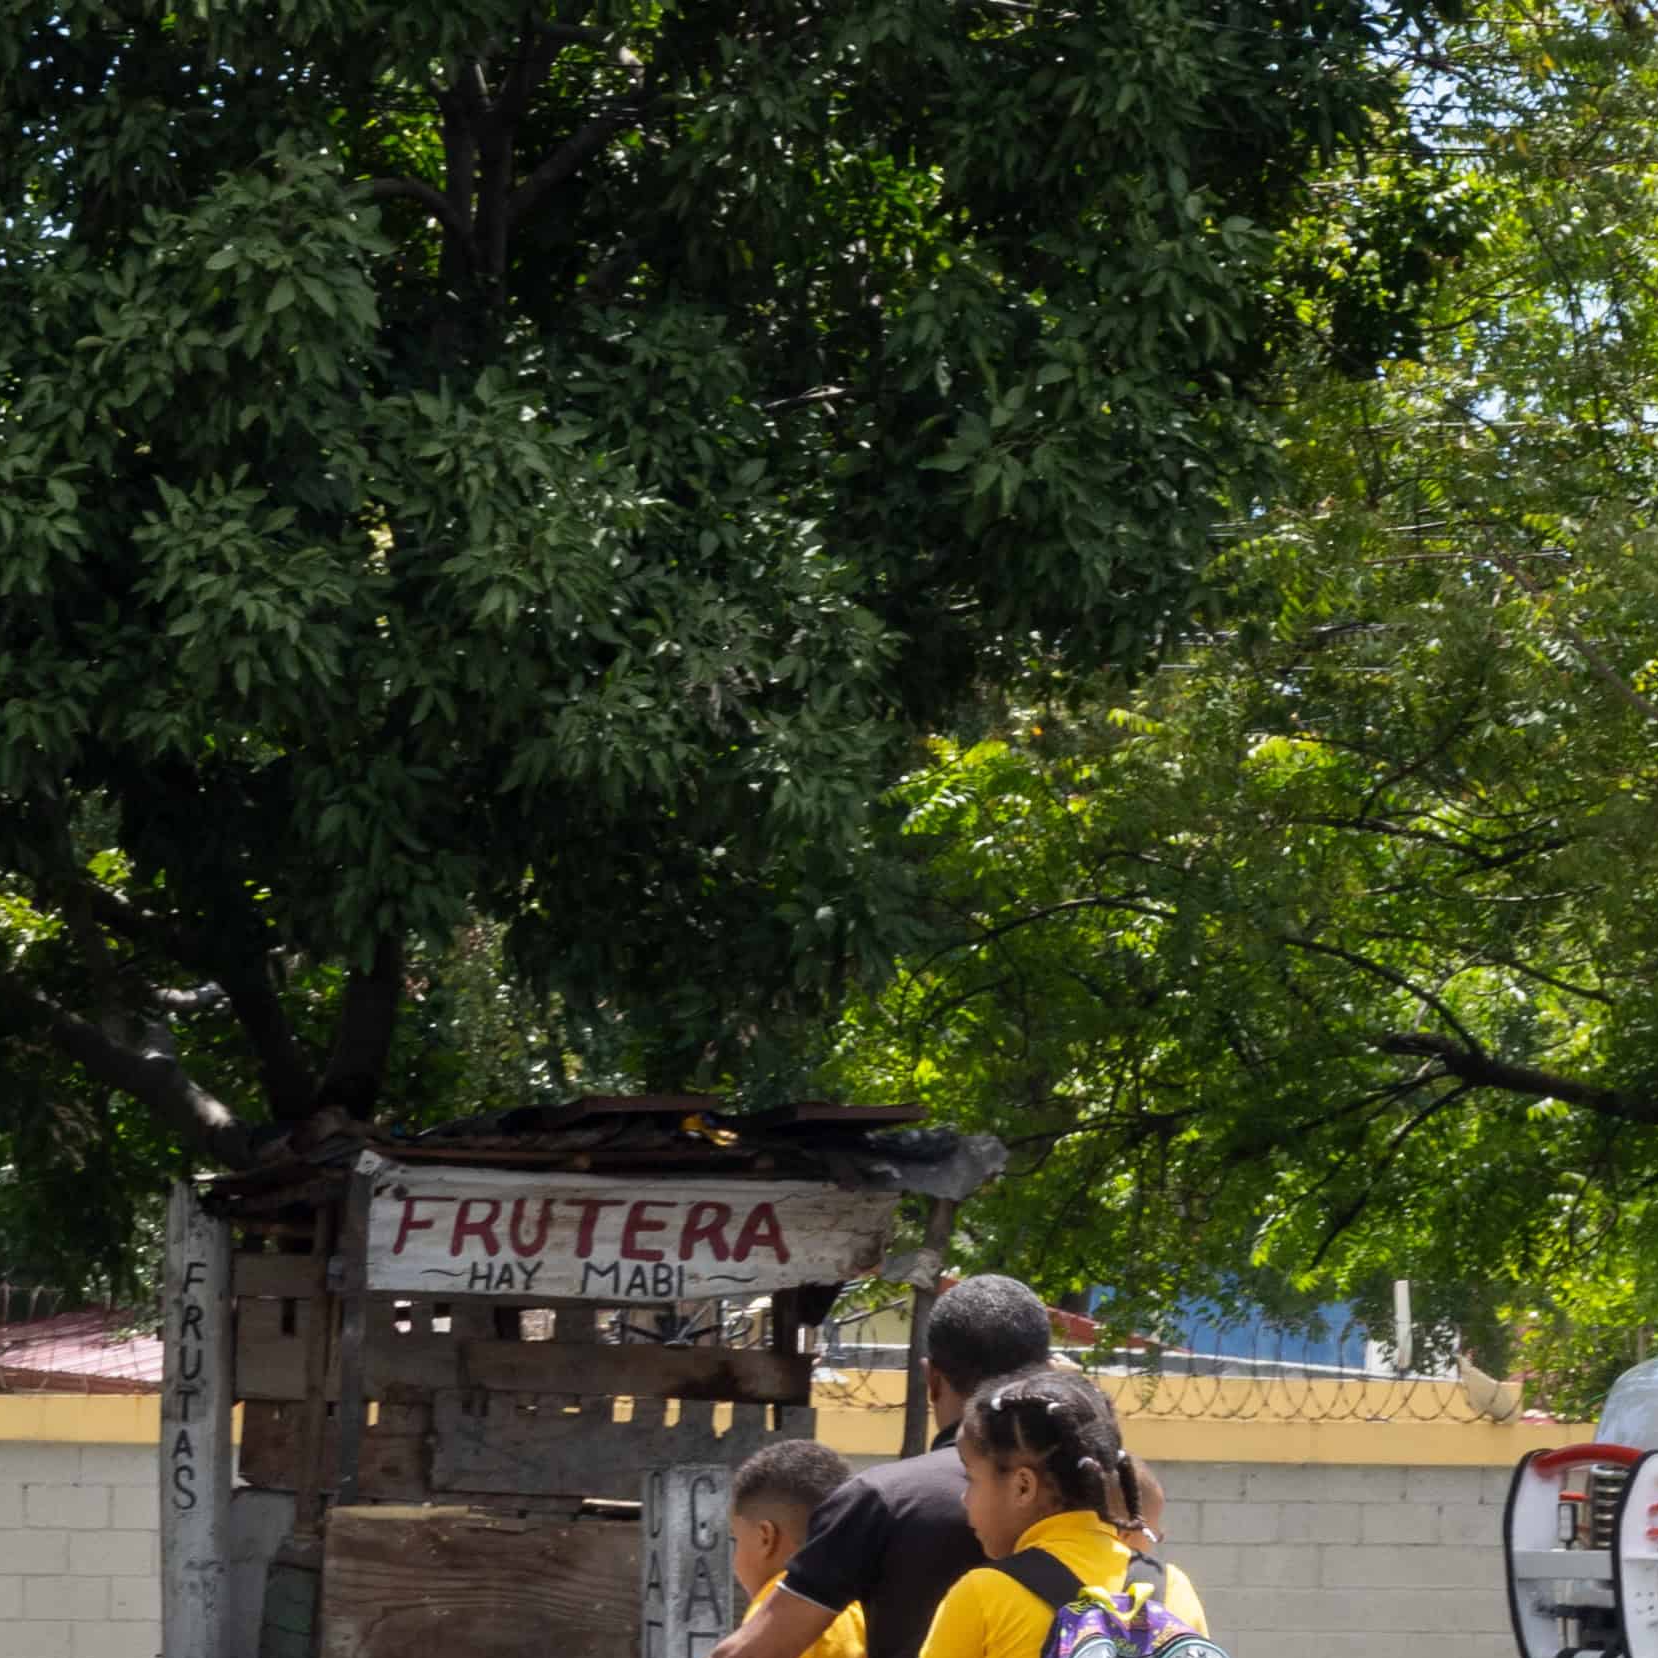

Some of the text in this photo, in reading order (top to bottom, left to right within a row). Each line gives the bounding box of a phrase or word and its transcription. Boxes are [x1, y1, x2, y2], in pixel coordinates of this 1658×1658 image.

[392, 1195, 791, 1264] FRUTERA
[468, 1261, 685, 1298] HAY MABI
[172, 1261, 207, 1510] FRUTAS
